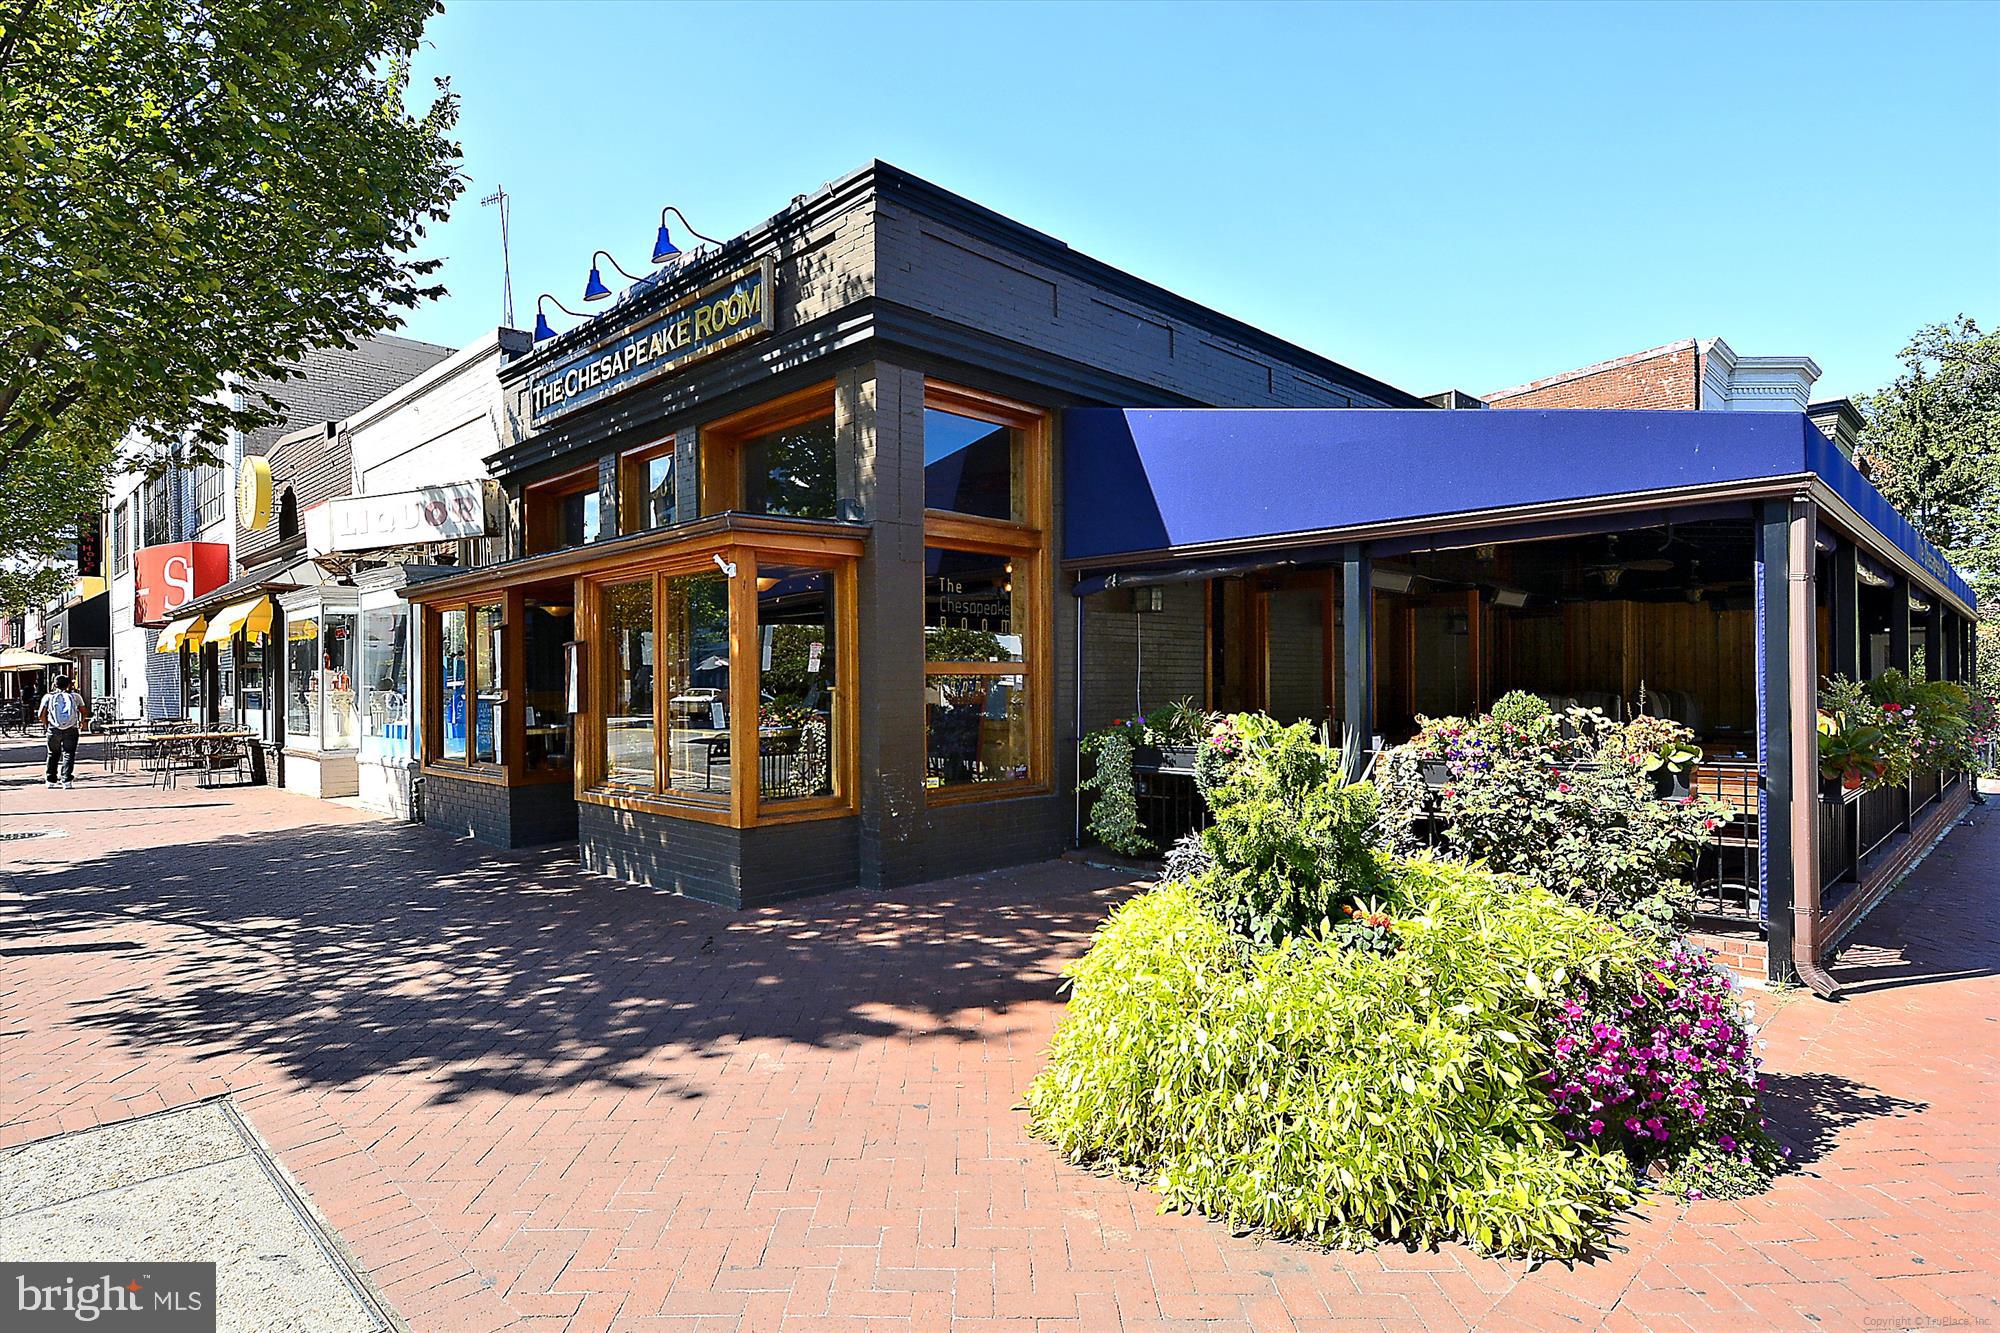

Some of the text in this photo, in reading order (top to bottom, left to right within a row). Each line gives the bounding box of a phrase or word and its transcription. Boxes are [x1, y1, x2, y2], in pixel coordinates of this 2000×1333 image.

[534, 283, 761, 412] THE CHESAPEAKE ROOM
[340, 496, 475, 537] LIQUOR
[939, 577, 962, 594] The
[940, 595, 1010, 617] Chesapeake
[940, 616, 1011, 635] Room
